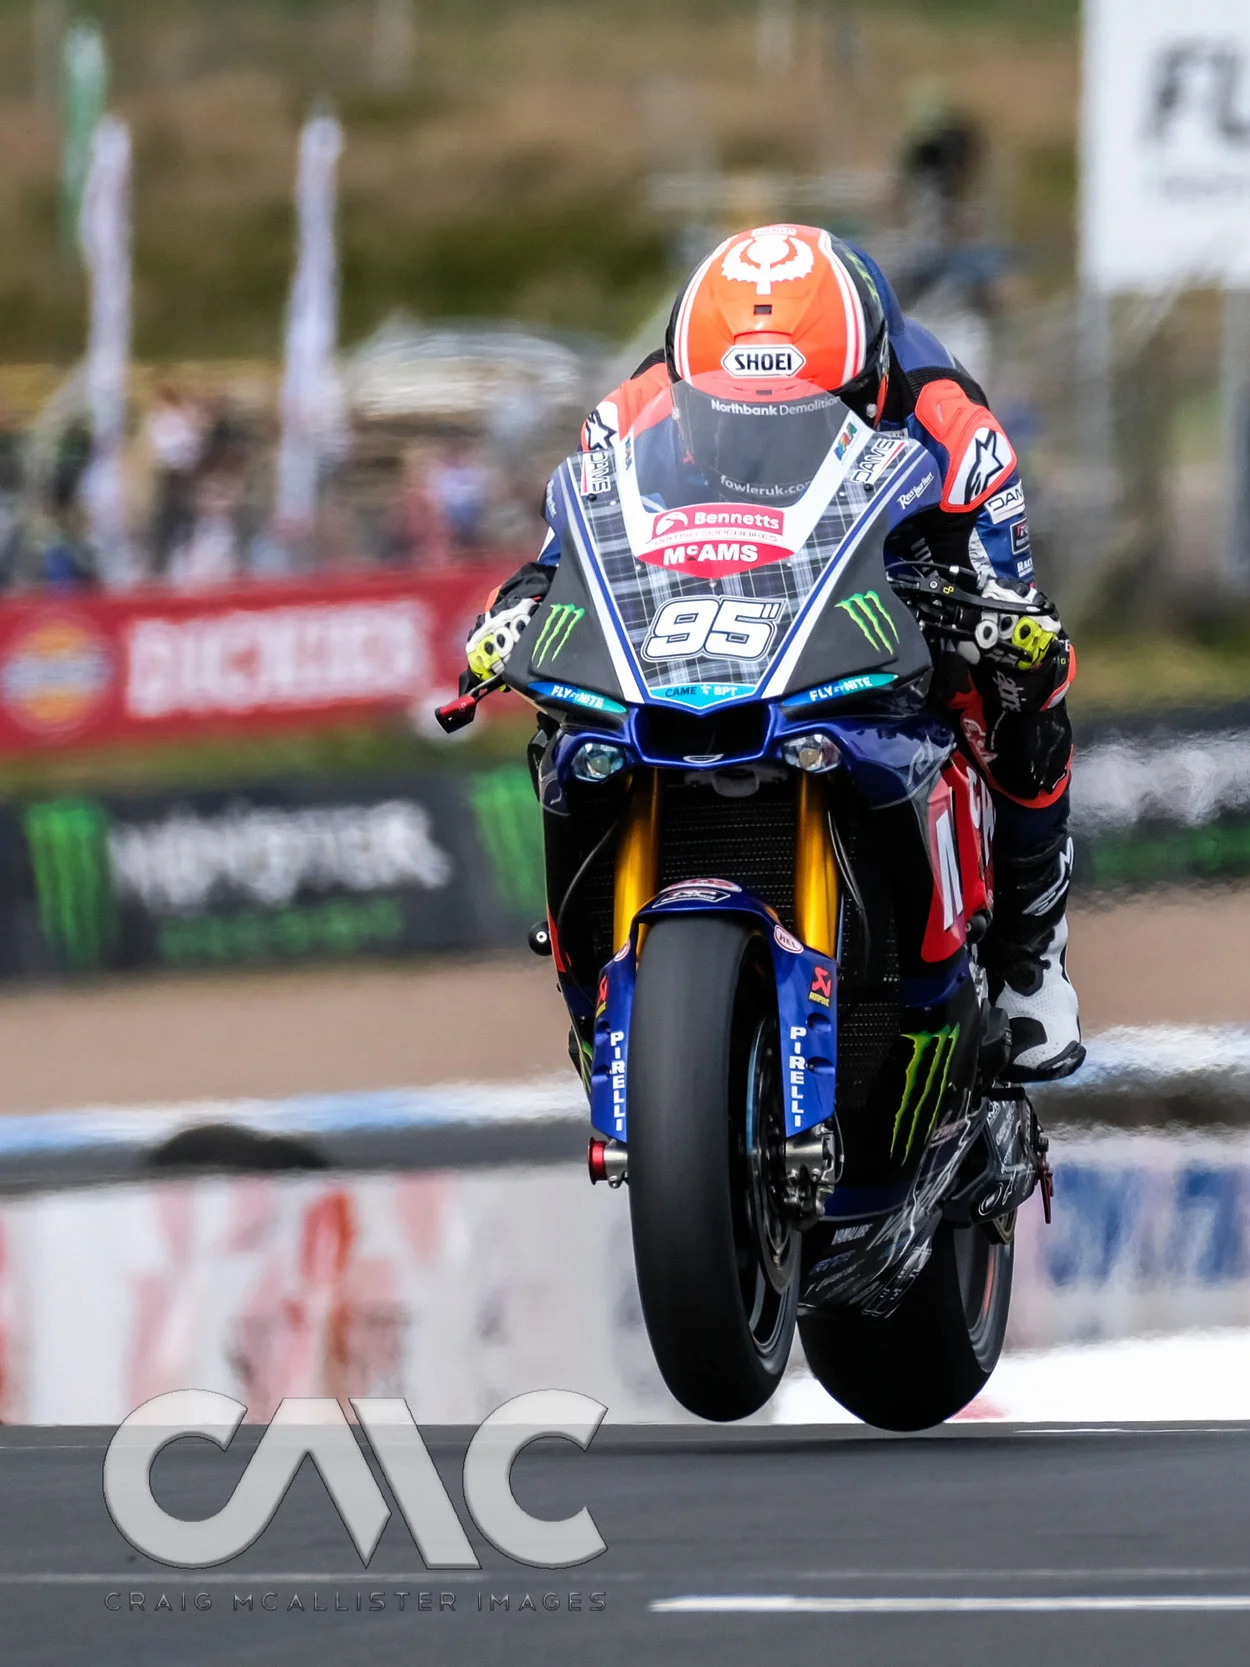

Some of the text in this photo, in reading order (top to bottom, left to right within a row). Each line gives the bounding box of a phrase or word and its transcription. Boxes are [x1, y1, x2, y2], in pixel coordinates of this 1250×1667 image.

[735, 353, 792, 371] SHOEI
[711, 396, 842, 416] Northbank Demolition
[720, 475, 811, 496] fowleruk.co
[987, 485, 1025, 512] DAM
[694, 511, 780, 530] Bennetts
[663, 543, 758, 566] McAMS
[551, 685, 571, 699] FLY
[577, 693, 605, 709] NITE
[665, 685, 738, 698] CAME BPT
[809, 686, 833, 702] FLY
[843, 677, 873, 691] NITE
[610, 1030, 626, 1132] PIRELLI
[788, 1026, 807, 1128] PIRELLI
